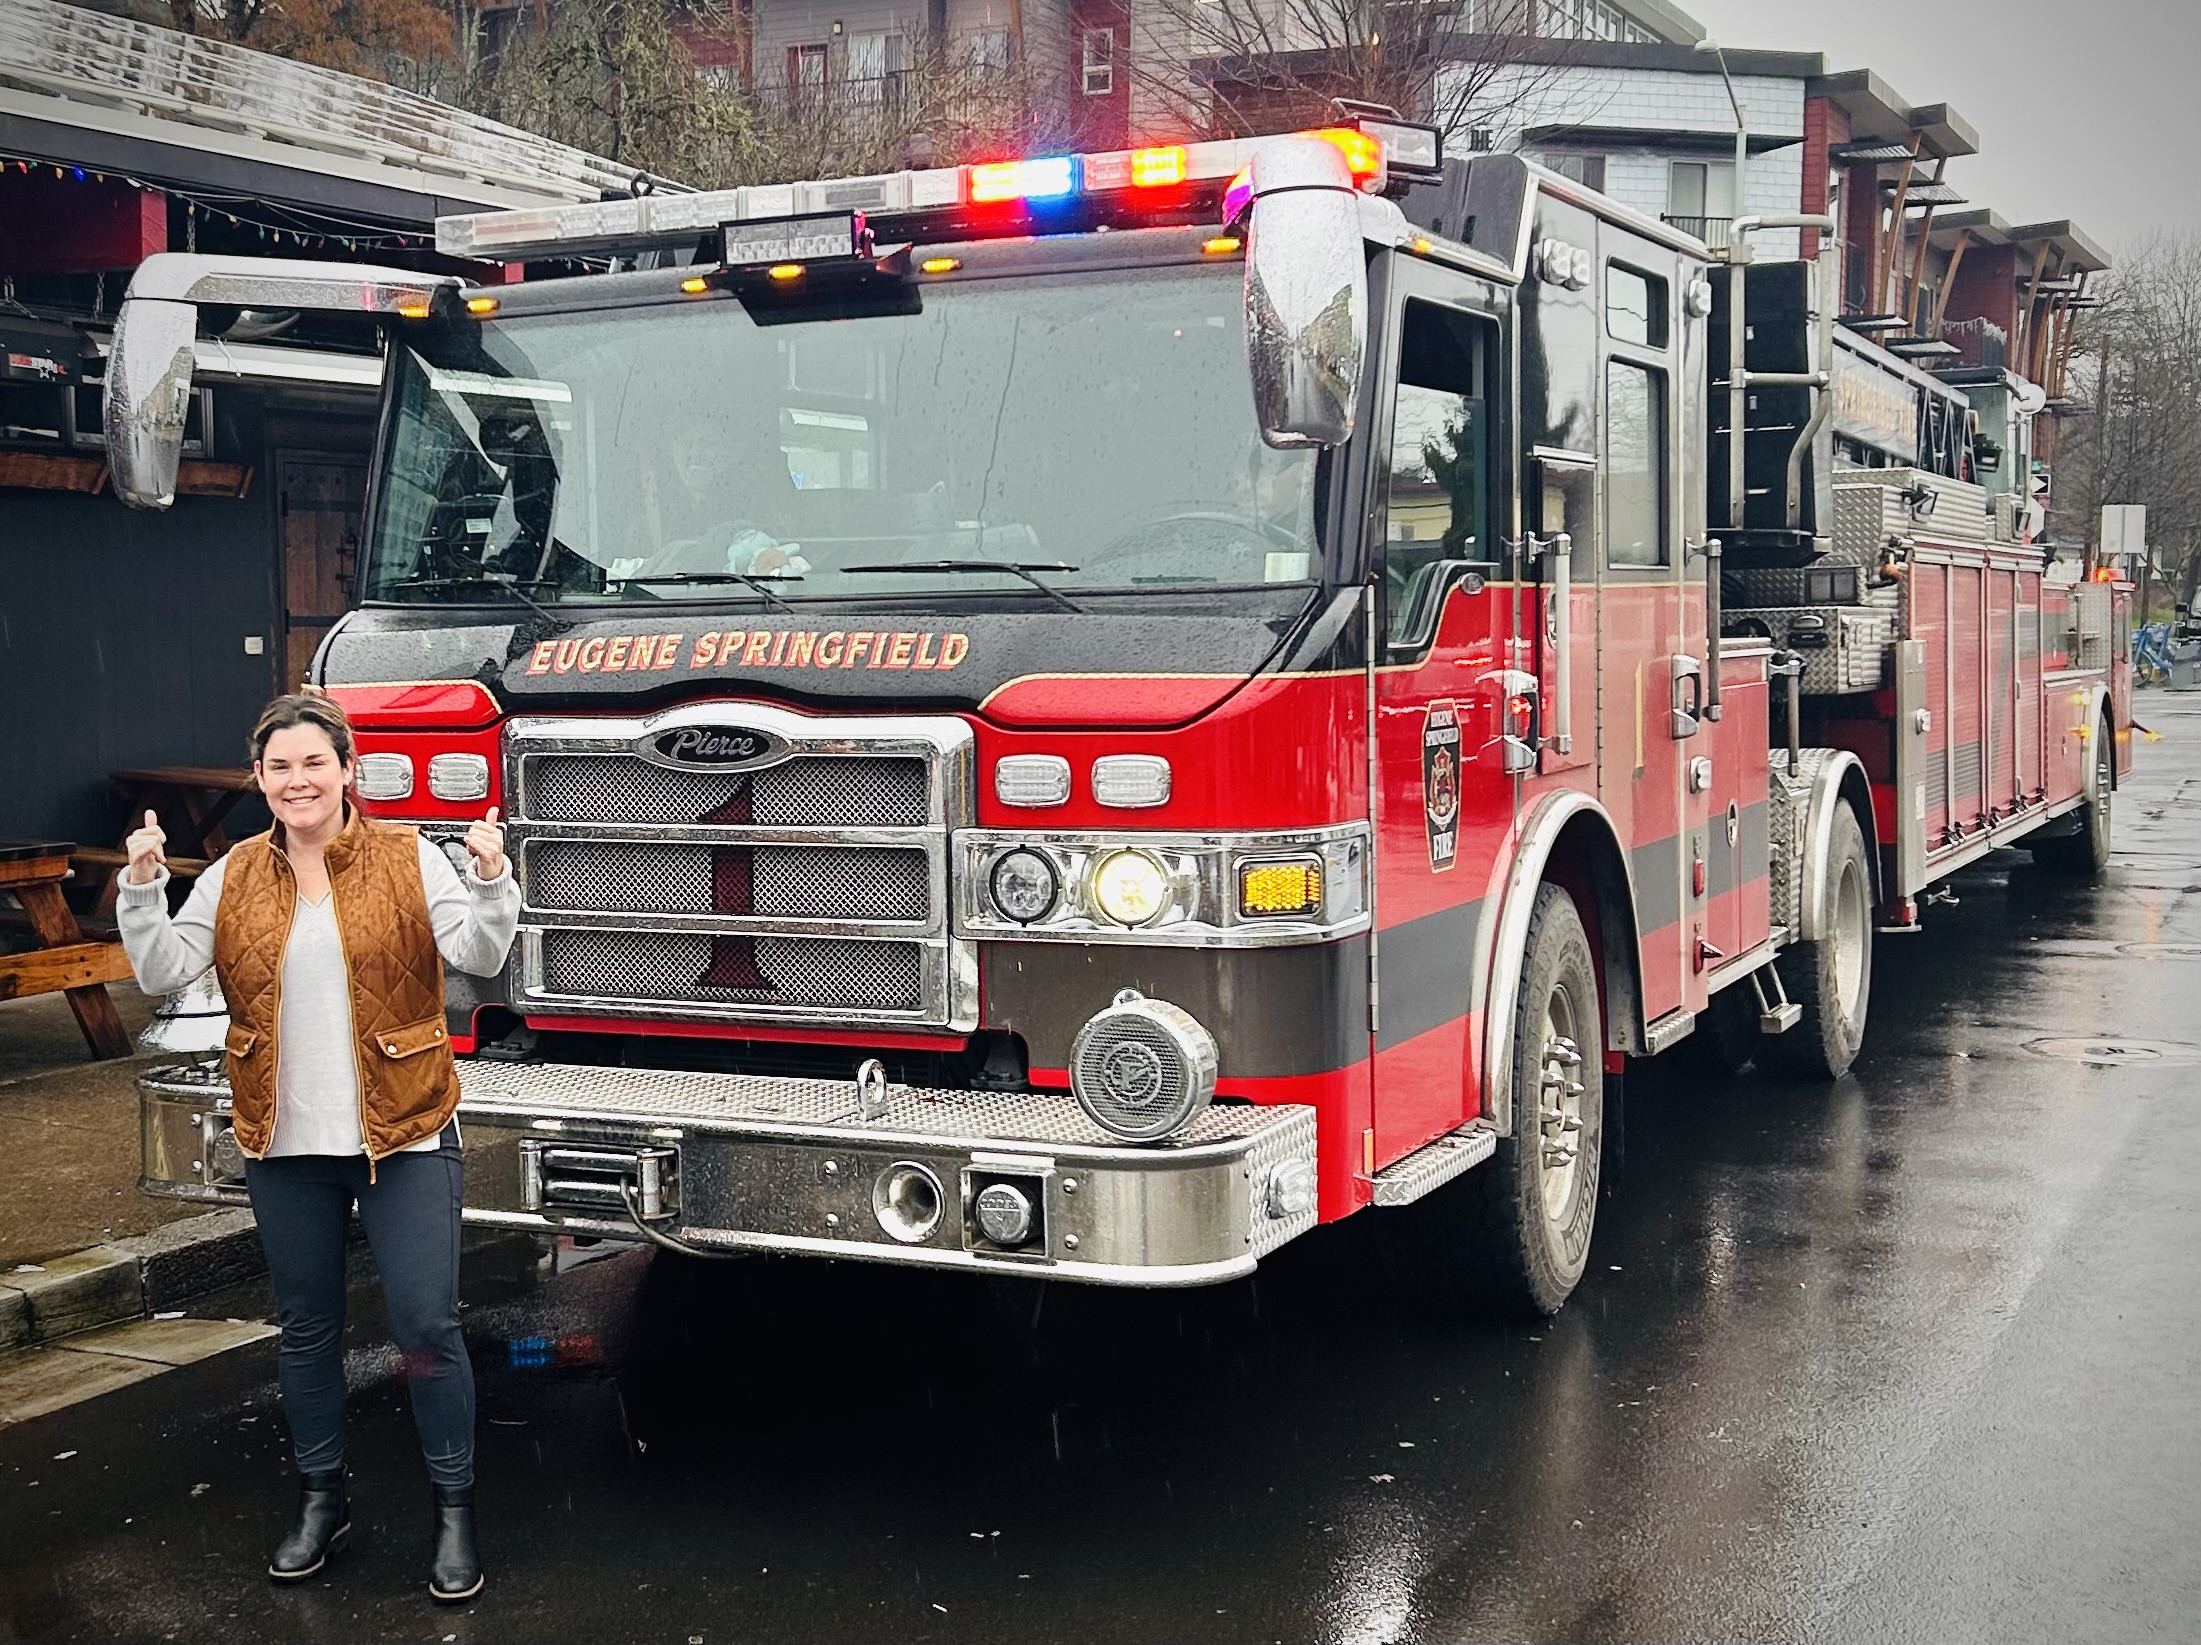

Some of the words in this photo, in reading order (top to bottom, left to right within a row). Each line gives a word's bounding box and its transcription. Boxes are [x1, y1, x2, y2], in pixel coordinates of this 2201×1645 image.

[525, 634, 684, 676] EUGENE
[690, 630, 970, 670] SPRINGFIELD
[670, 729, 756, 760] Pierce
[698, 772, 777, 990] 1
